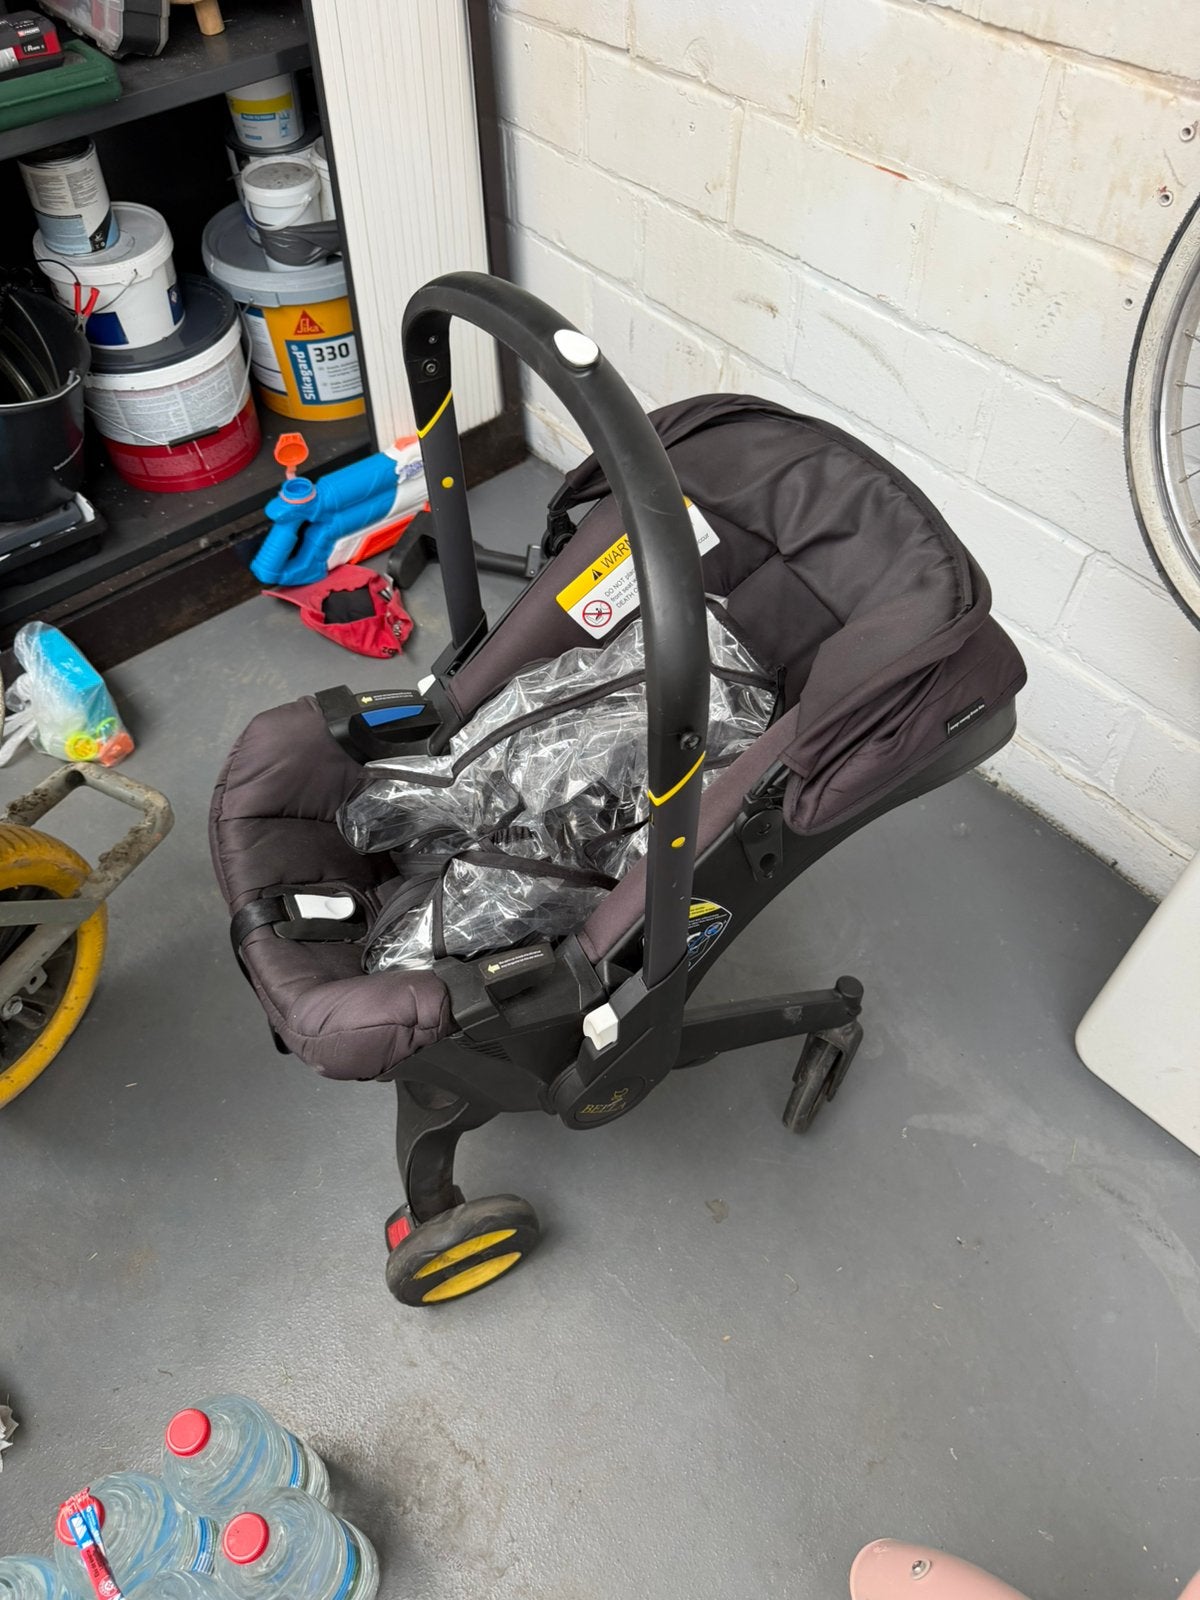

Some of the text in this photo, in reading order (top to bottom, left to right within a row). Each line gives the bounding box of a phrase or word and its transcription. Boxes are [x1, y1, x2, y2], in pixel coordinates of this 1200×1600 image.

[297, 318, 320, 334] Sika
[313, 343, 350, 362] 330
[613, 577, 626, 590] NOT
